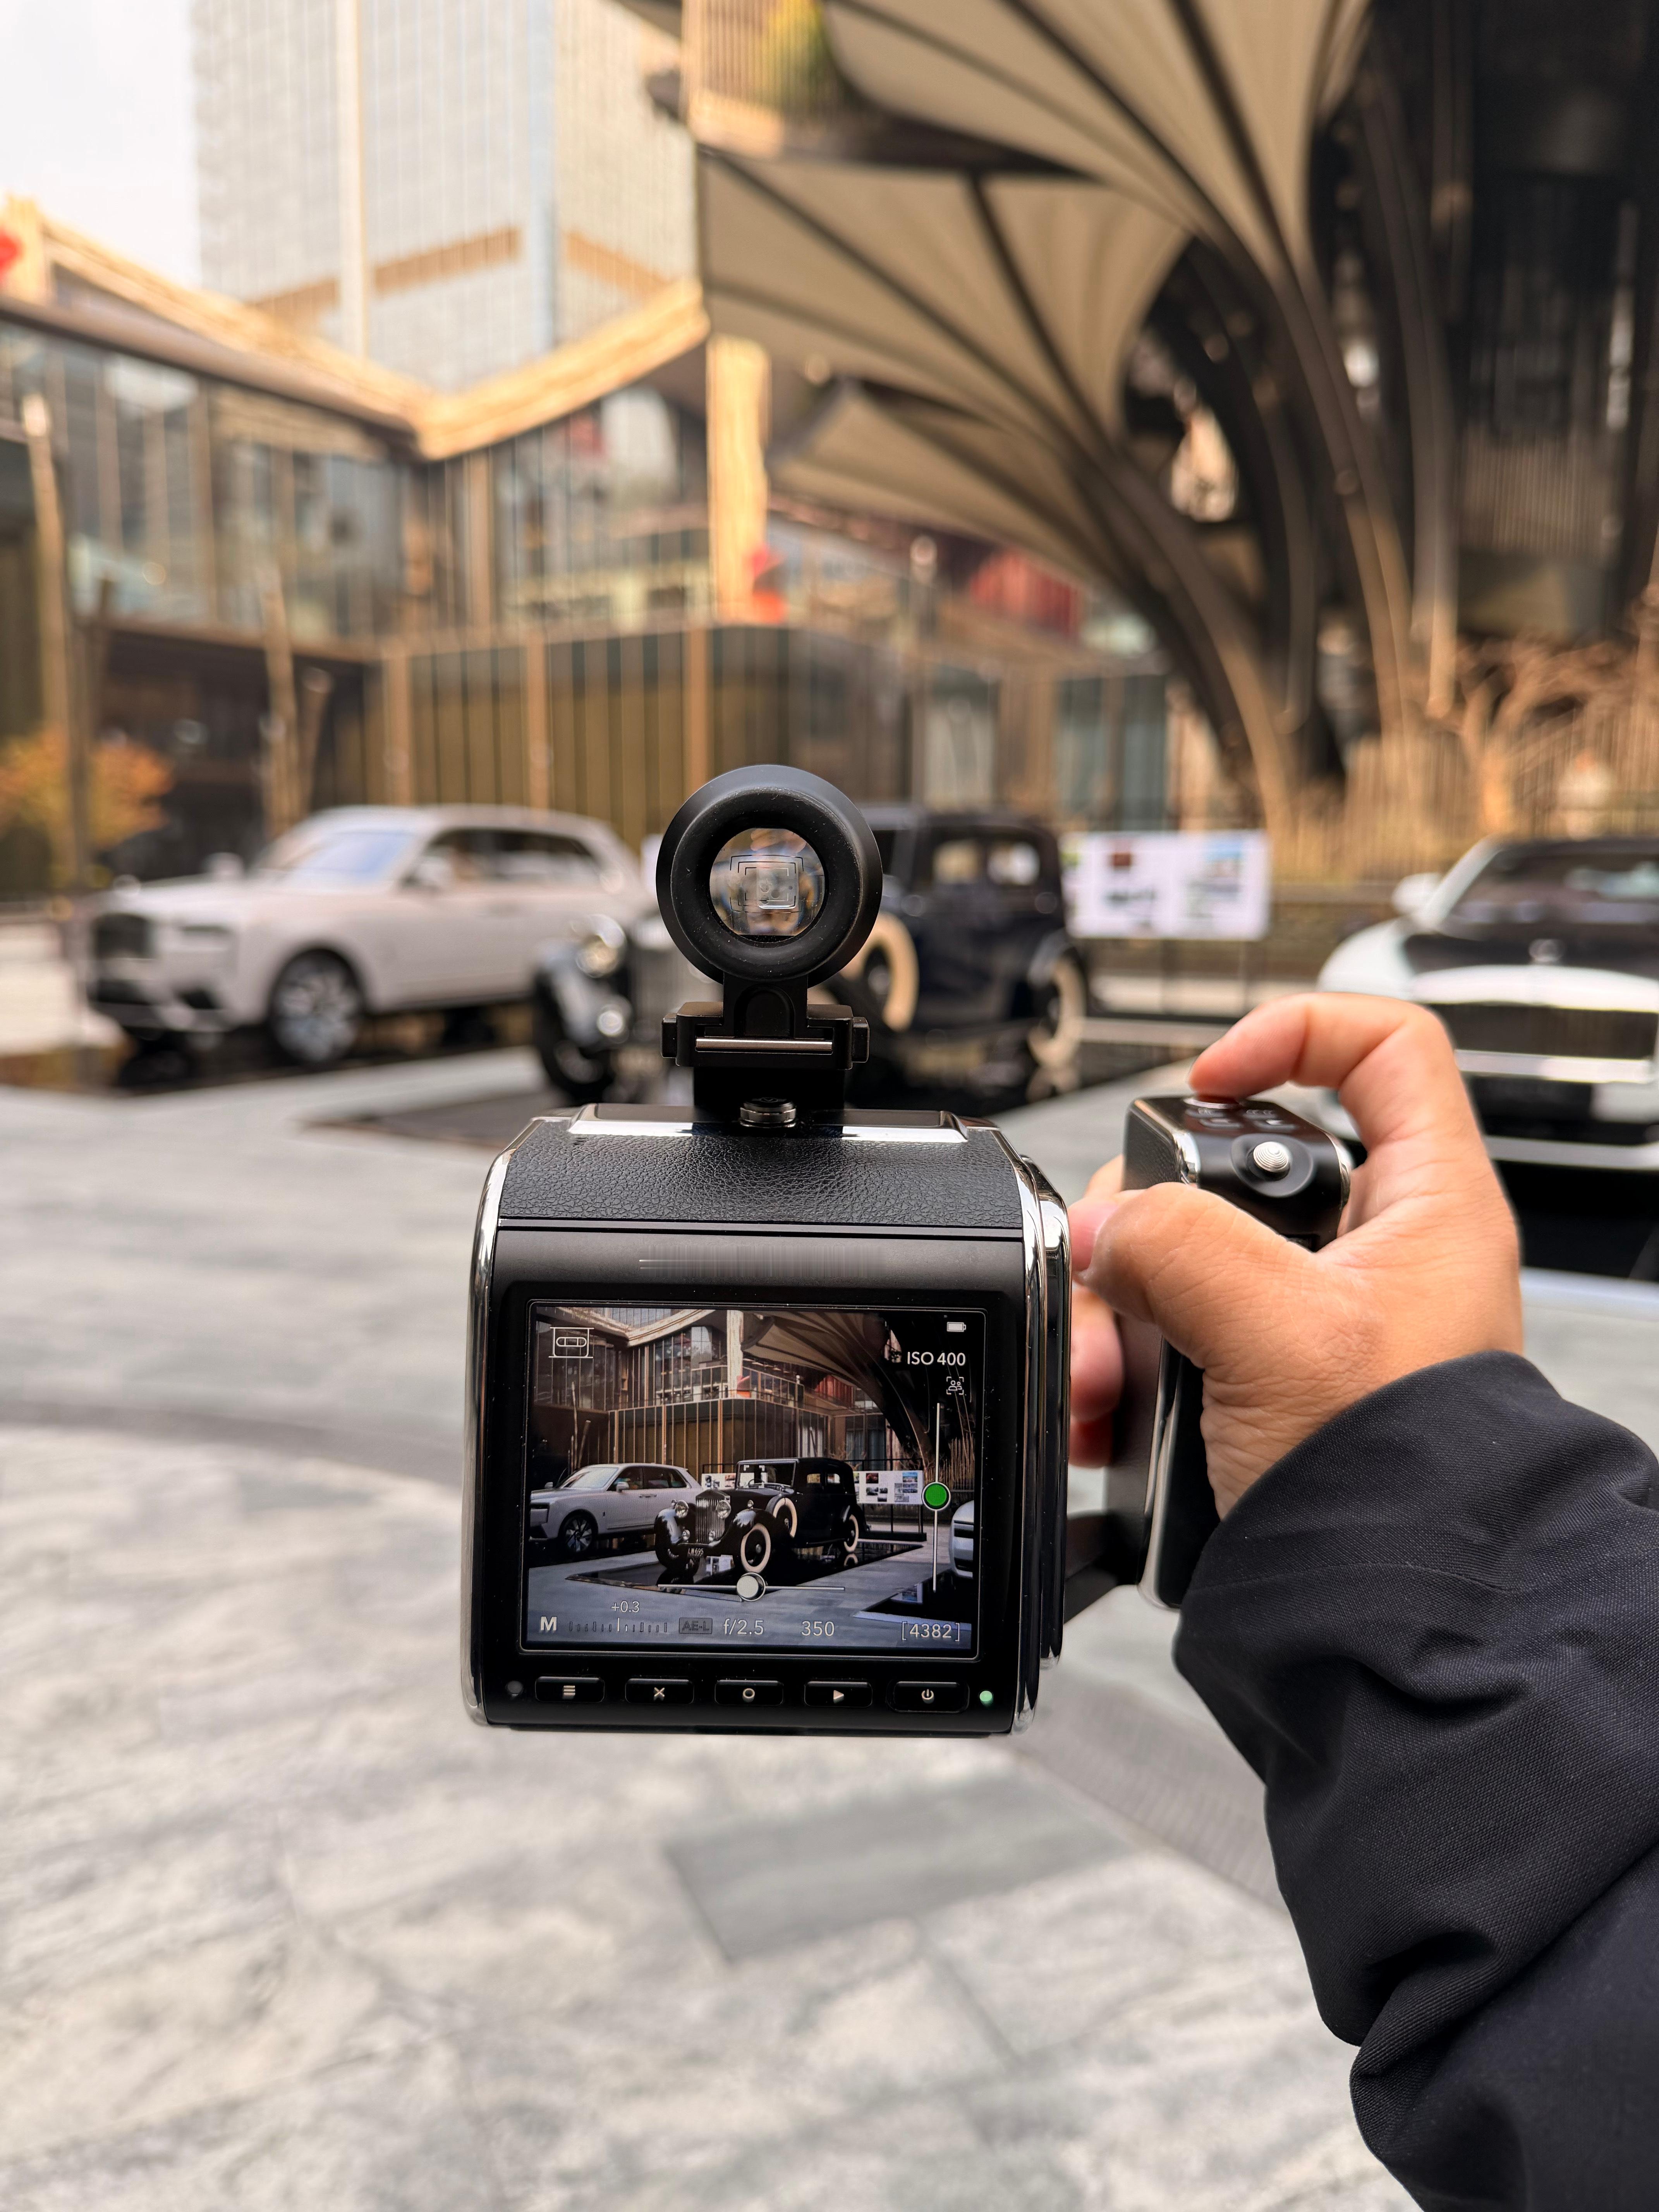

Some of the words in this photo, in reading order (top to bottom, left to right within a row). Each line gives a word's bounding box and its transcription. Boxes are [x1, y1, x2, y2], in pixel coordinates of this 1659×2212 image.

[907, 1351, 934, 1365] ISO
[937, 1352, 966, 1366] 400
[611, 1600, 640, 1613] +0.3
[540, 1616, 557, 1631] M
[682, 1620, 710, 1632] AE-L
[723, 1618, 764, 1635] f/2.5
[801, 1621, 835, 1637] 350
